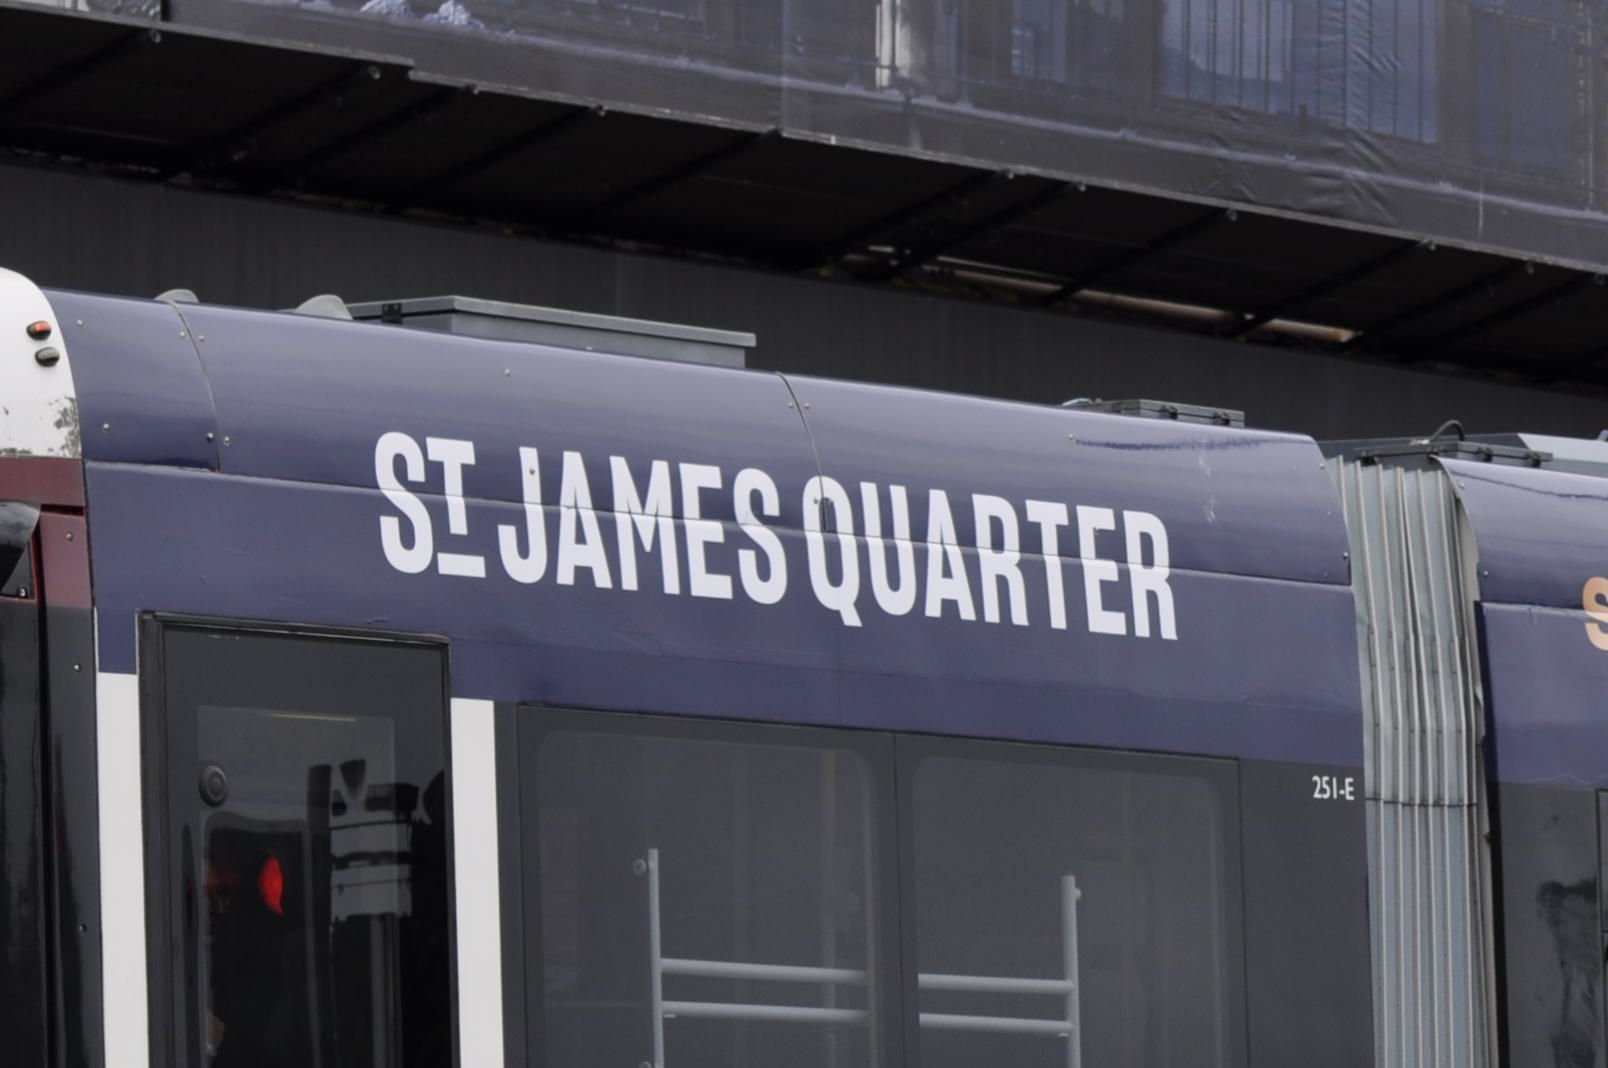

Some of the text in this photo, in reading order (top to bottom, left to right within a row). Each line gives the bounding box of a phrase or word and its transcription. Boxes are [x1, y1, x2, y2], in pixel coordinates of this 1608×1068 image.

[375, 431, 1178, 641] ST JAMES QUARTER
[1311, 775, 1355, 800] 251-E
